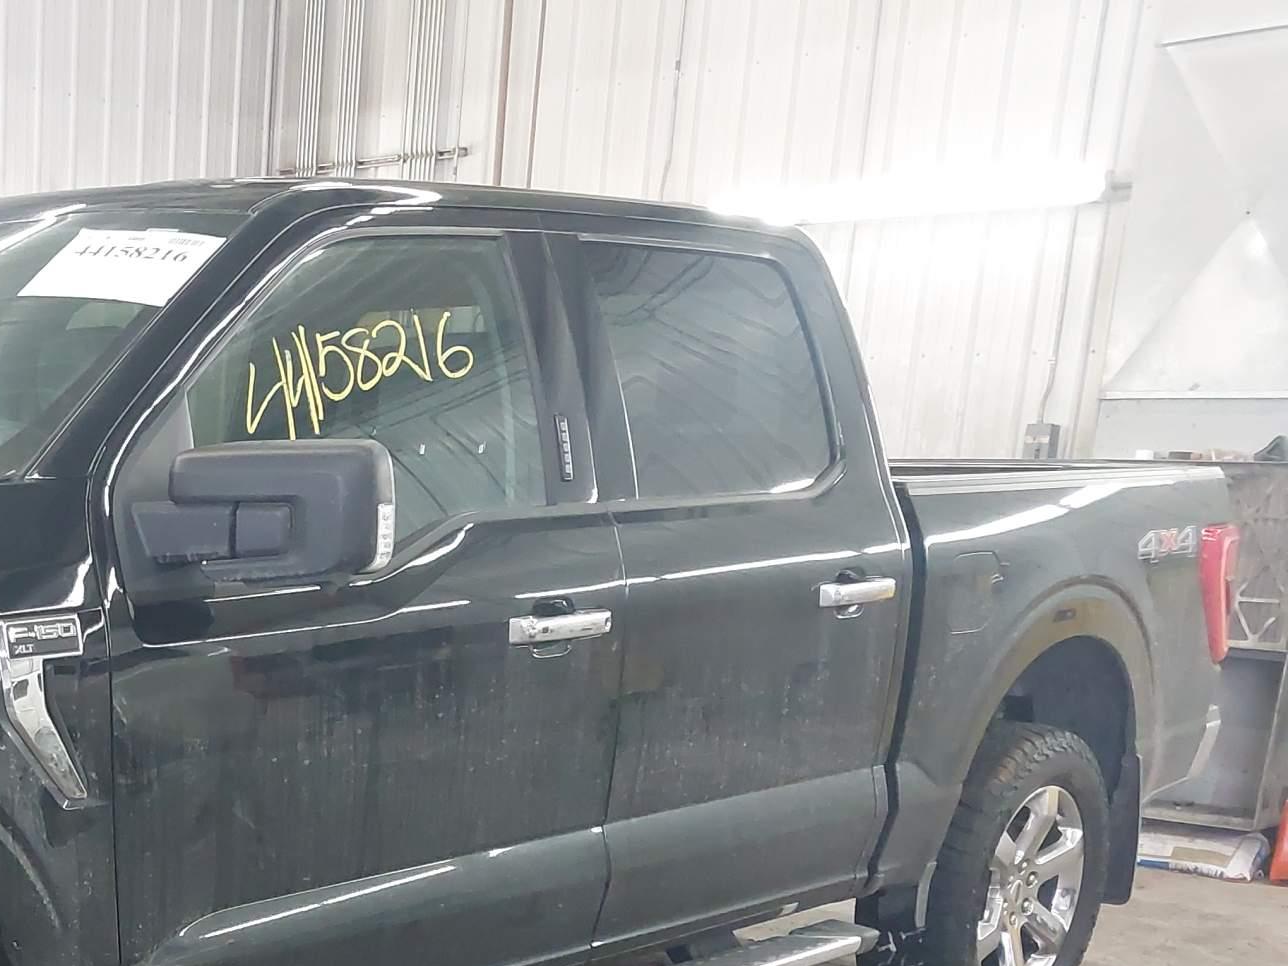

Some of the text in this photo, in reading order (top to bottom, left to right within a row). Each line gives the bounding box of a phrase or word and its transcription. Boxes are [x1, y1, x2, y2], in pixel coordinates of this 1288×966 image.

[75, 245, 189, 262] 44158216
[245, 308, 475, 441] 44158216
[8, 622, 77, 643] F-150
[13, 643, 35, 655] XLT
